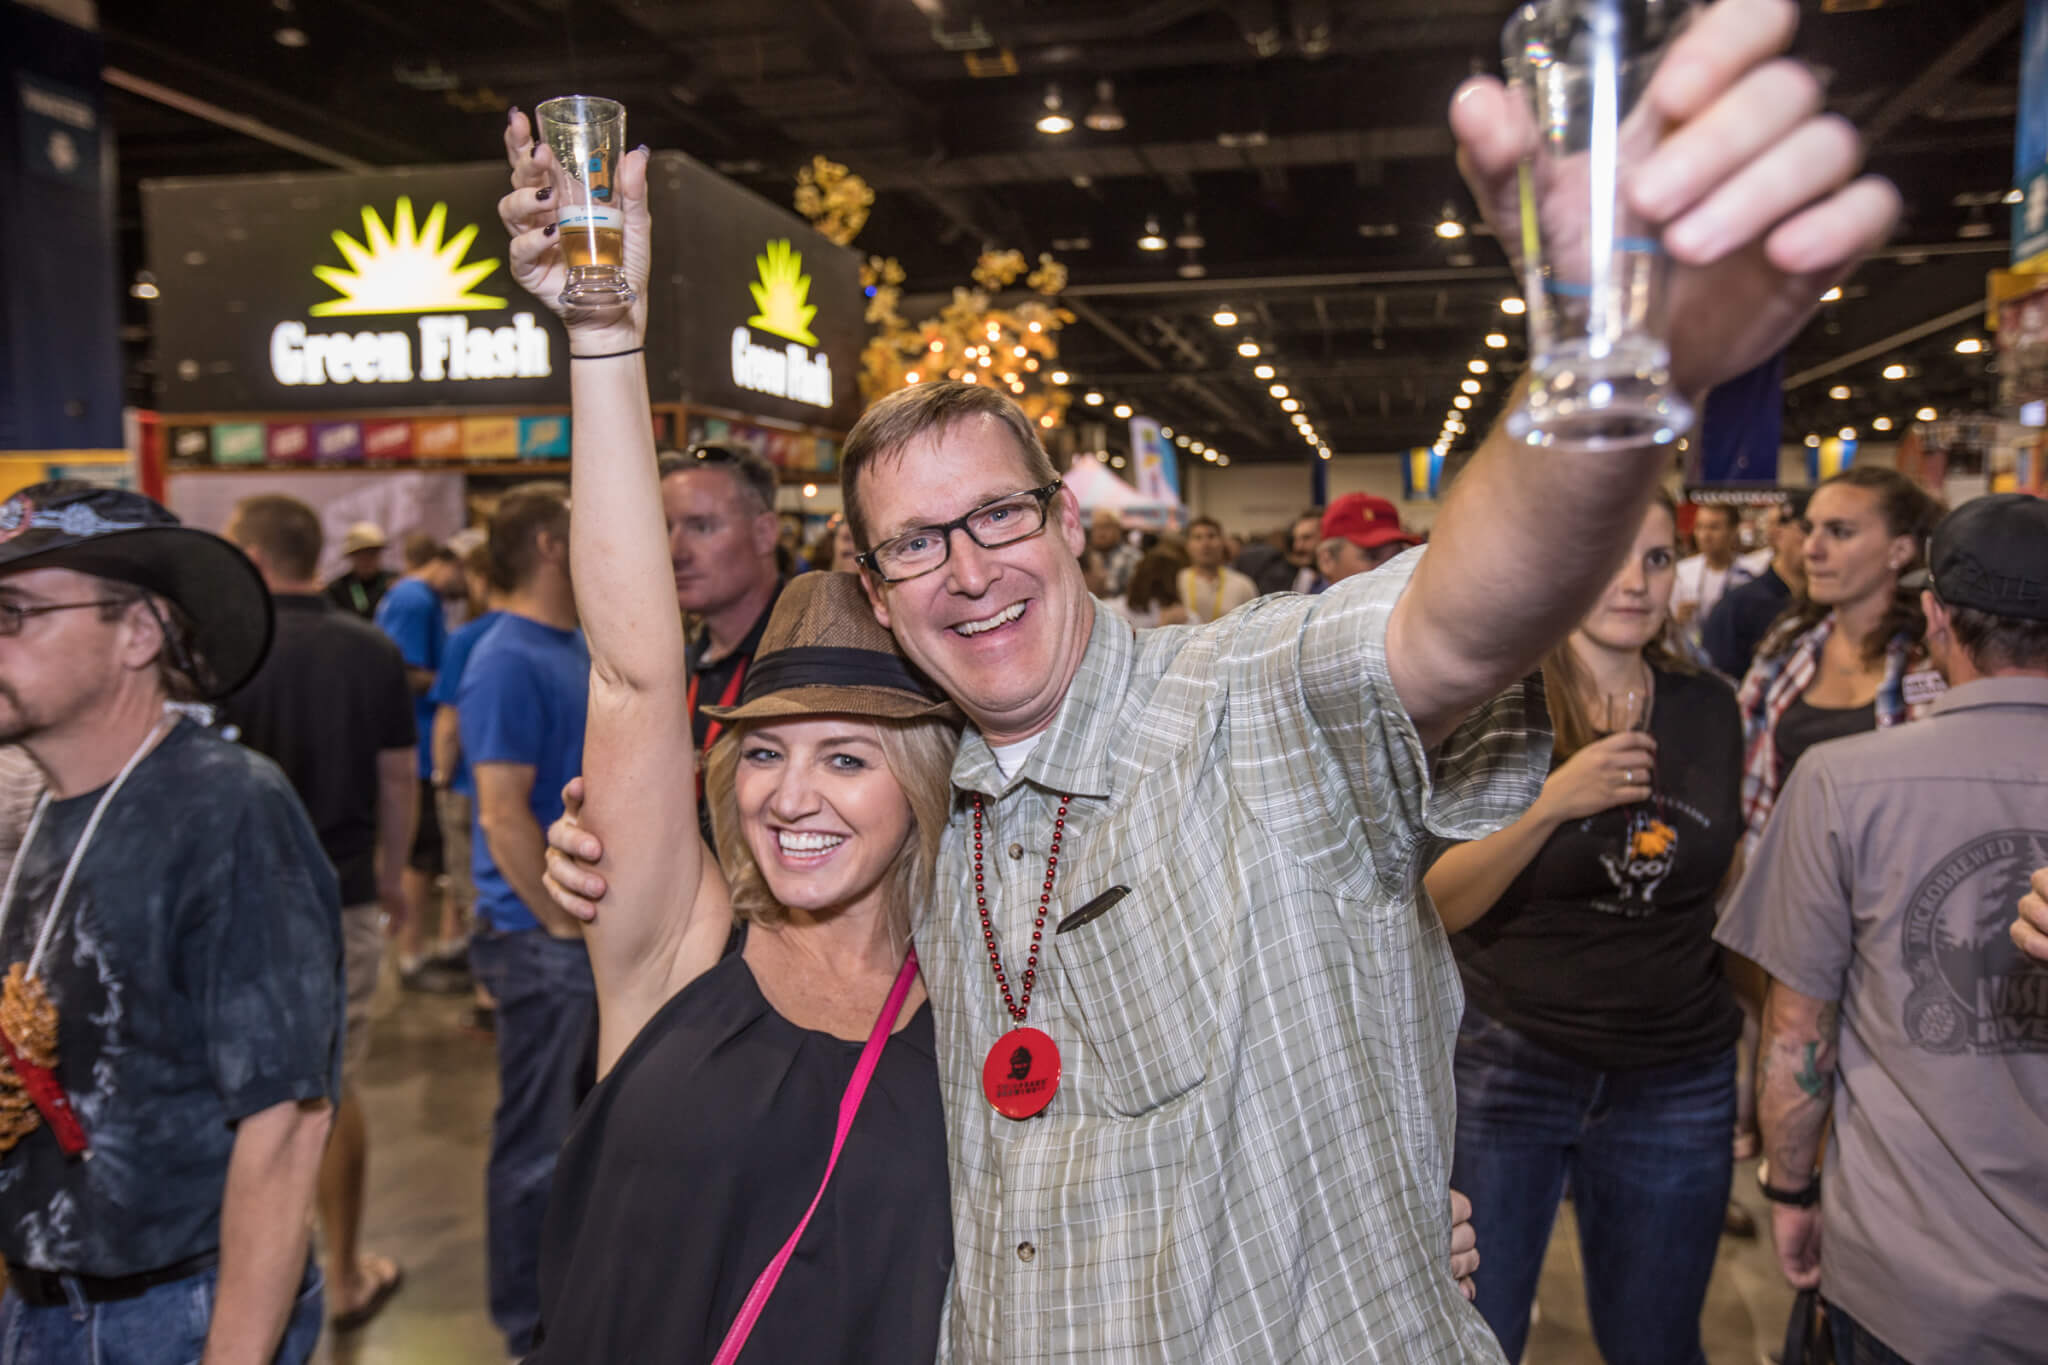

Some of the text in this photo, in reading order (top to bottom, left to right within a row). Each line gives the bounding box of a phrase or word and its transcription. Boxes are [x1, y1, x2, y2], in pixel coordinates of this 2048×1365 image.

[270, 312, 552, 386] Green Flash
[1908, 838, 2015, 945] MICROBREWED
